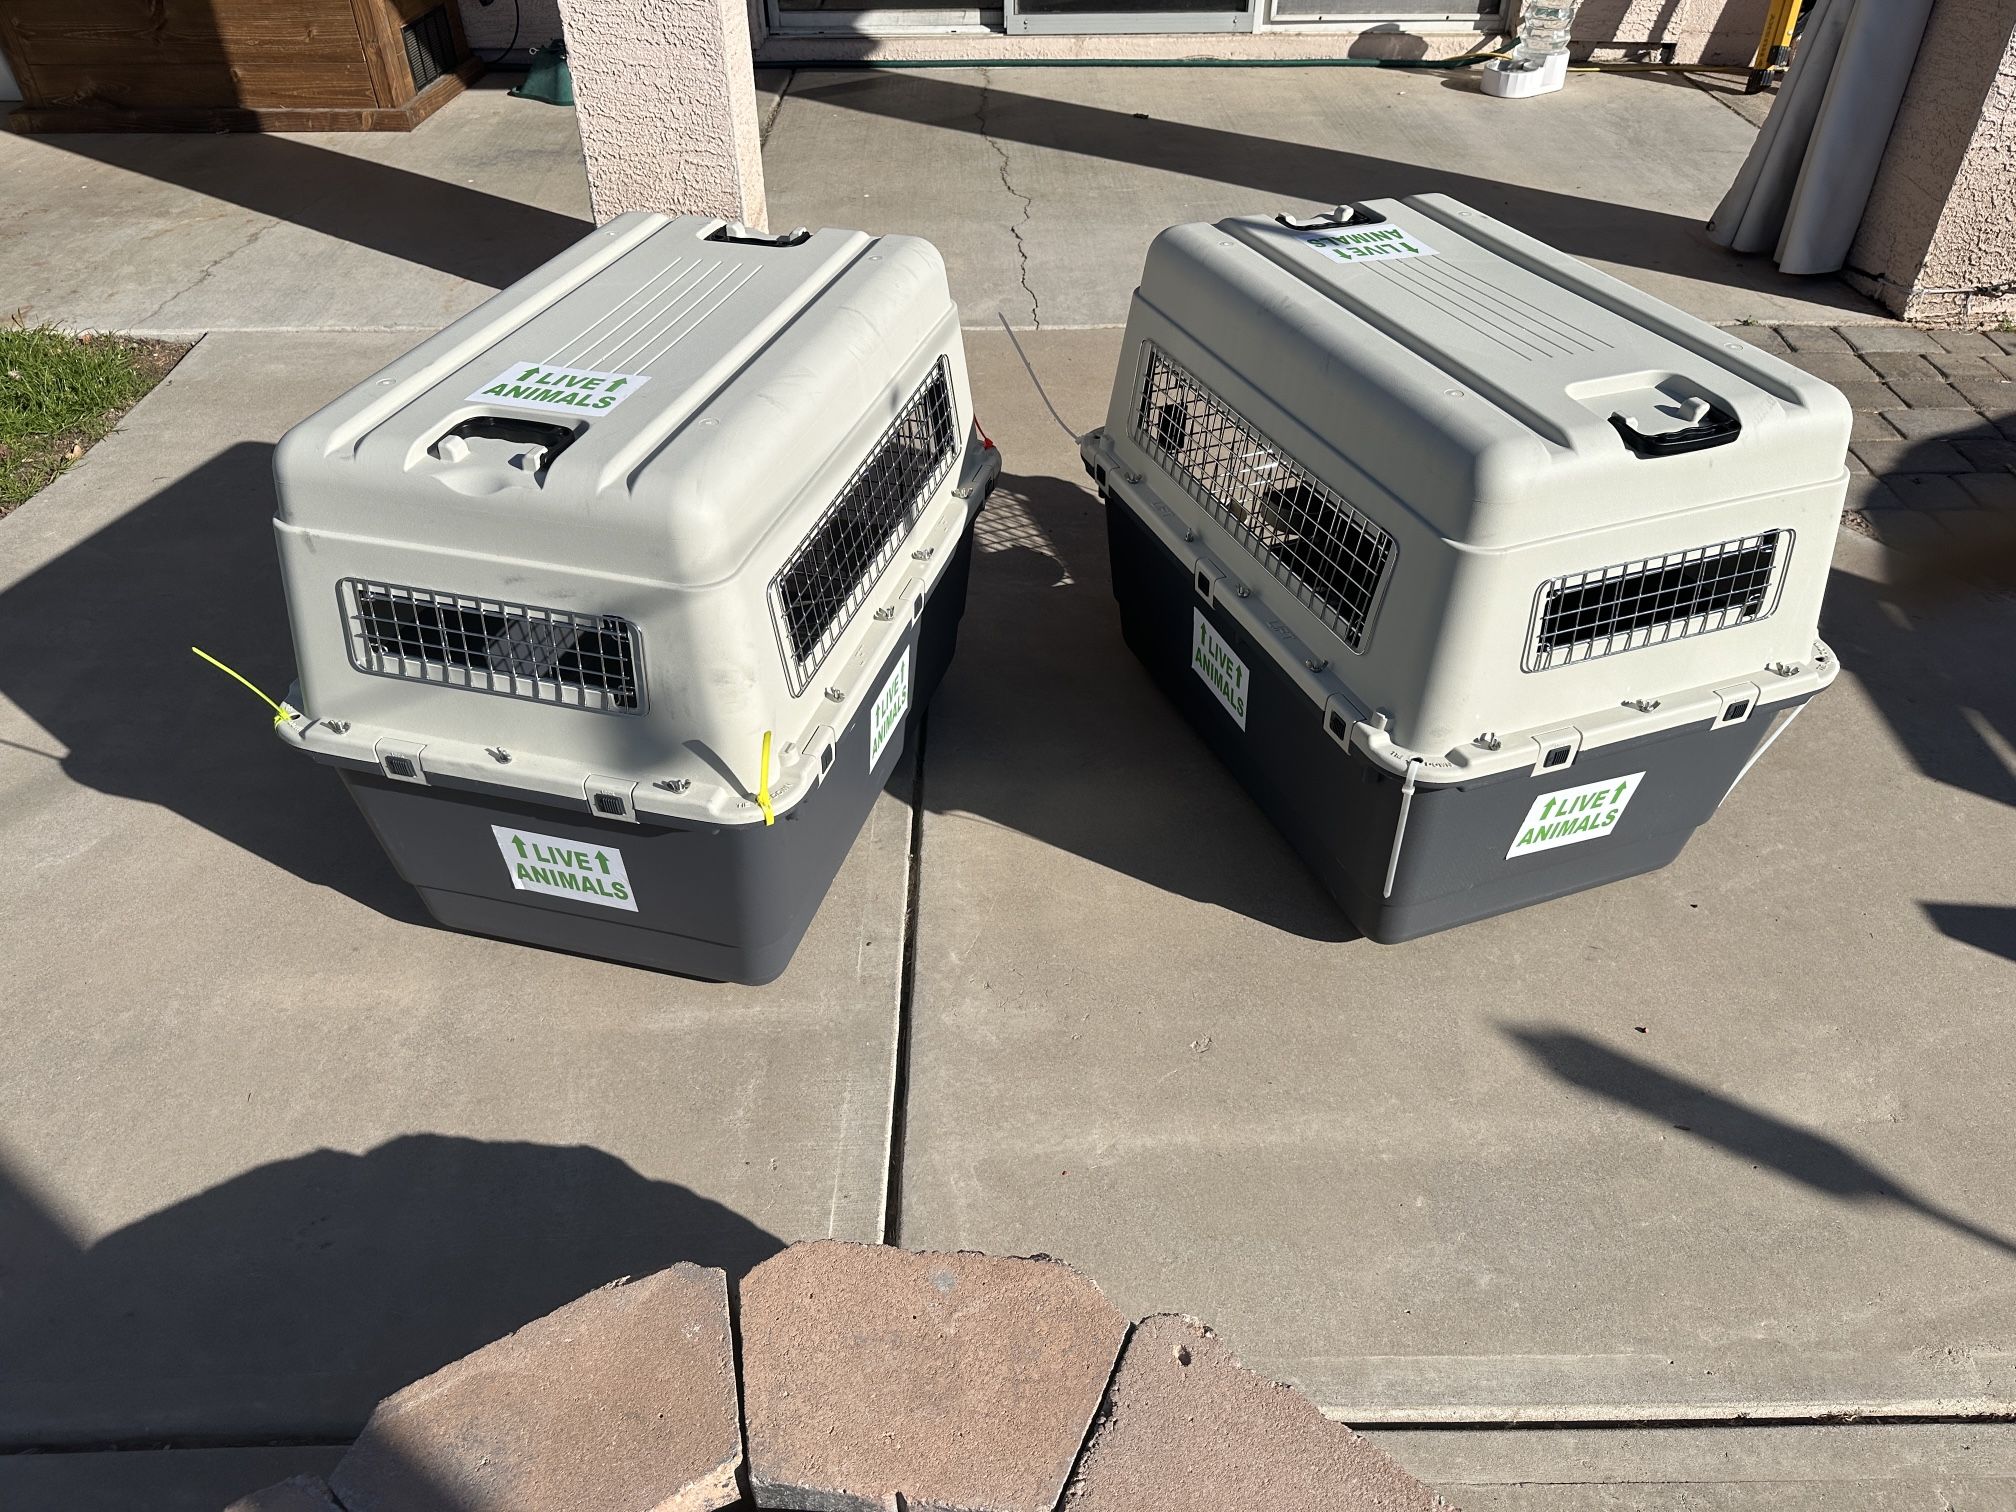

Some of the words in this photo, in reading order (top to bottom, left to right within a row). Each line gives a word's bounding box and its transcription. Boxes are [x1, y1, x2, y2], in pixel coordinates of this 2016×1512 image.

[1307, 228, 1404, 248] ANIMALS
[1349, 243, 1403, 257] LIVE
[481, 383, 617, 409] ANIMALS
[535, 372, 606, 391] LIVE
[1208, 635, 1234, 680] LIVE
[881, 674, 899, 718] LIVE
[1195, 646, 1244, 718] ANIMALS
[872, 685, 907, 759] ANIMALS
[1555, 789, 1611, 817] LIVE
[1516, 808, 1619, 848] ANIMALS
[532, 843, 593, 872] LIVE
[517, 862, 629, 901] ANIMALS
